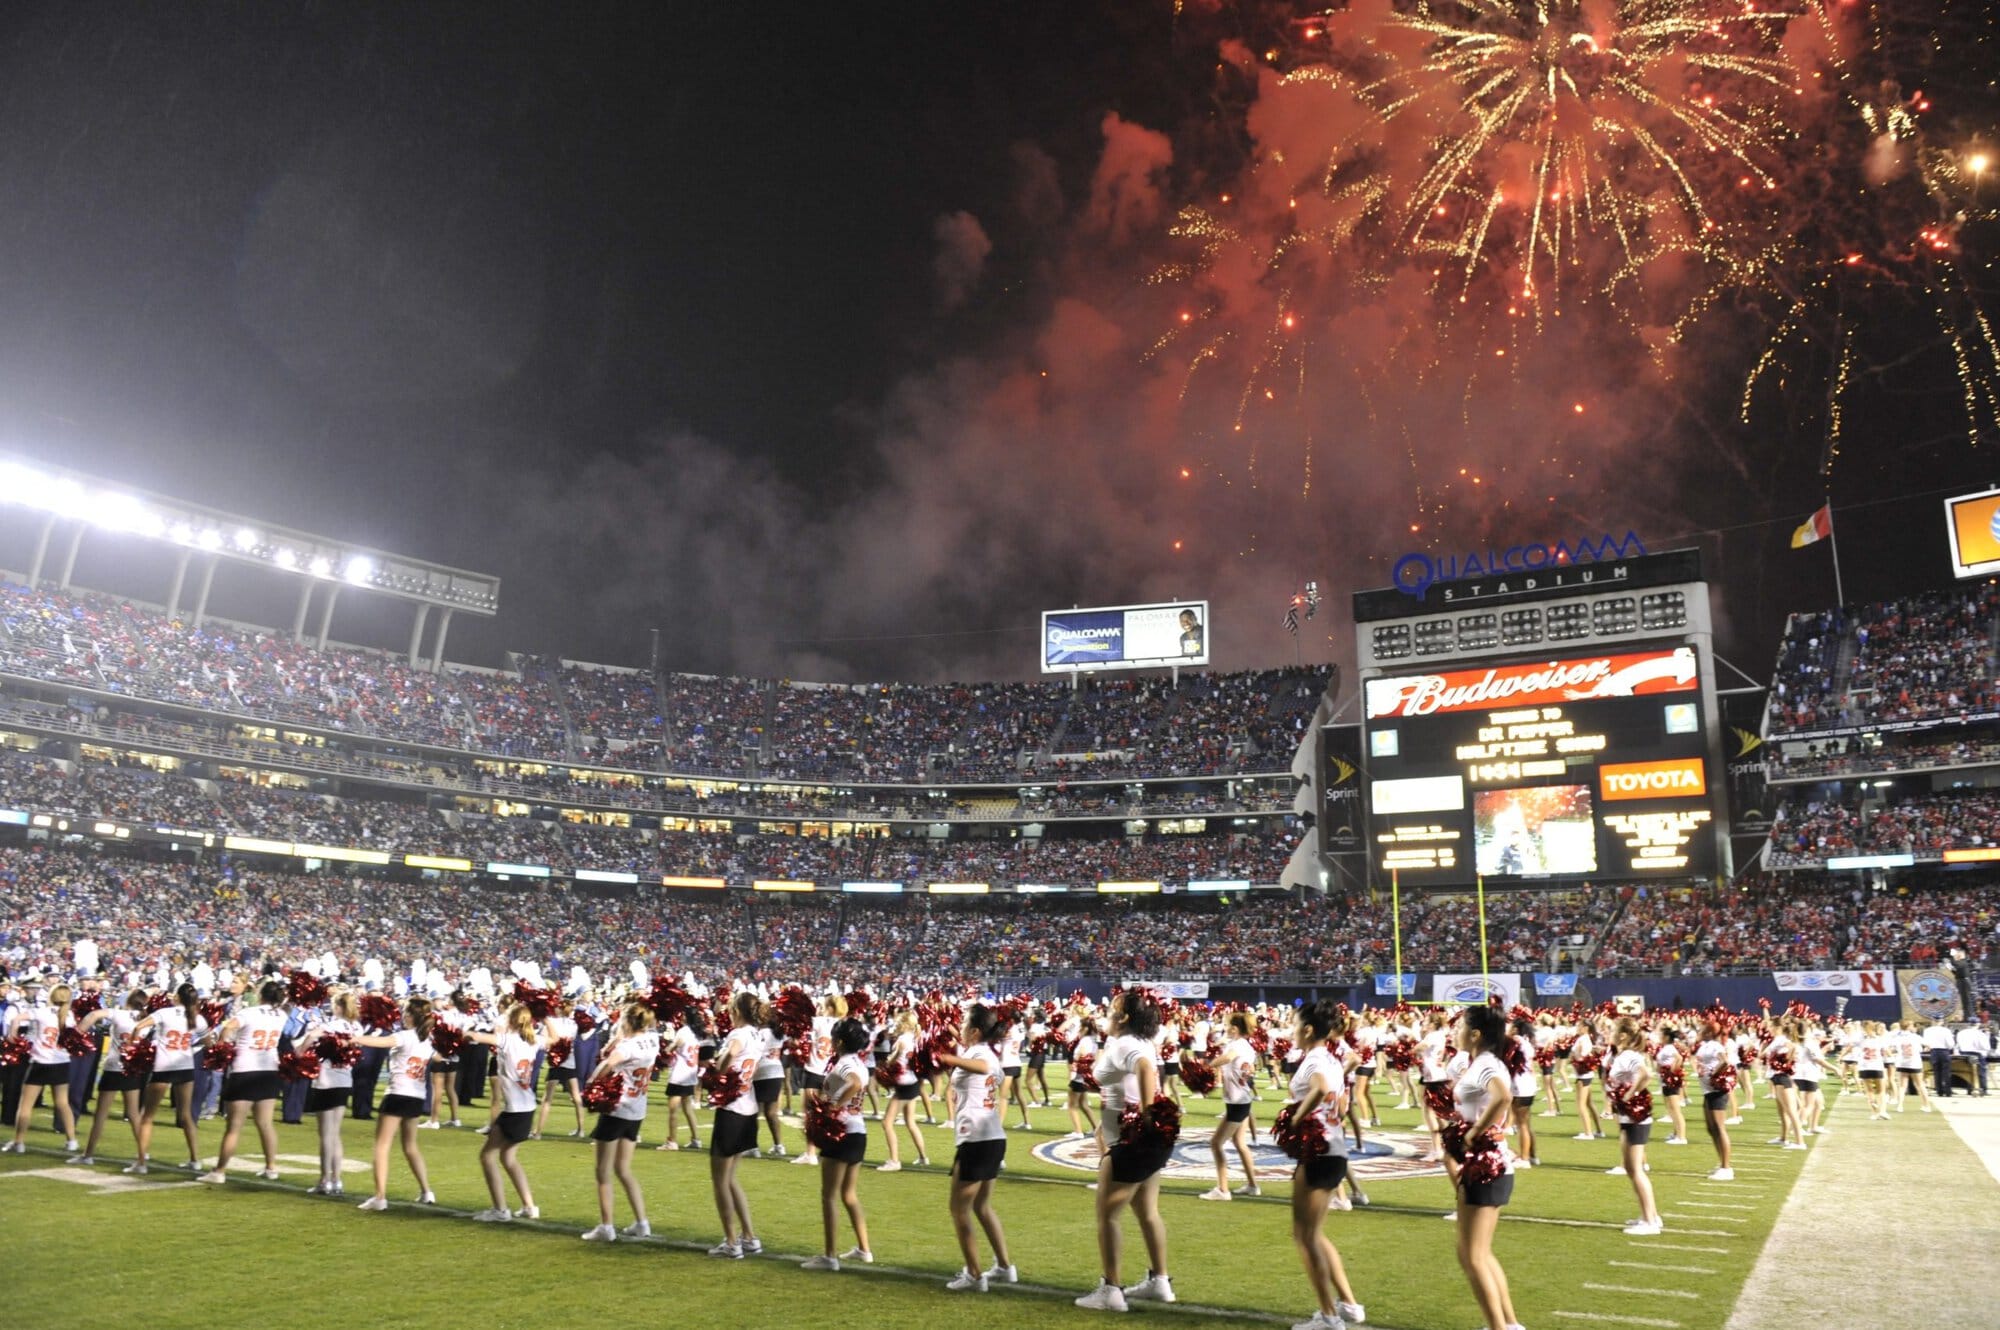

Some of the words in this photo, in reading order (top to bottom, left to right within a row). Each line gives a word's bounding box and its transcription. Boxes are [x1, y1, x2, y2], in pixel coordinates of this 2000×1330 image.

[1394, 530, 1646, 601] QUALCOMM
[1445, 566, 1628, 600] STADIUM
[1050, 627, 1121, 645] QUALCOMM
[1400, 659, 1612, 717] Budweiser
[1478, 727, 1504, 742] DR
[1508, 721, 1574, 740] PEPPER
[1604, 769, 1700, 792] TOYOTA
[1326, 787, 1359, 801] Sprint
[1454, 980, 1480, 991] PACIFIC
[1859, 972, 1886, 994] N
